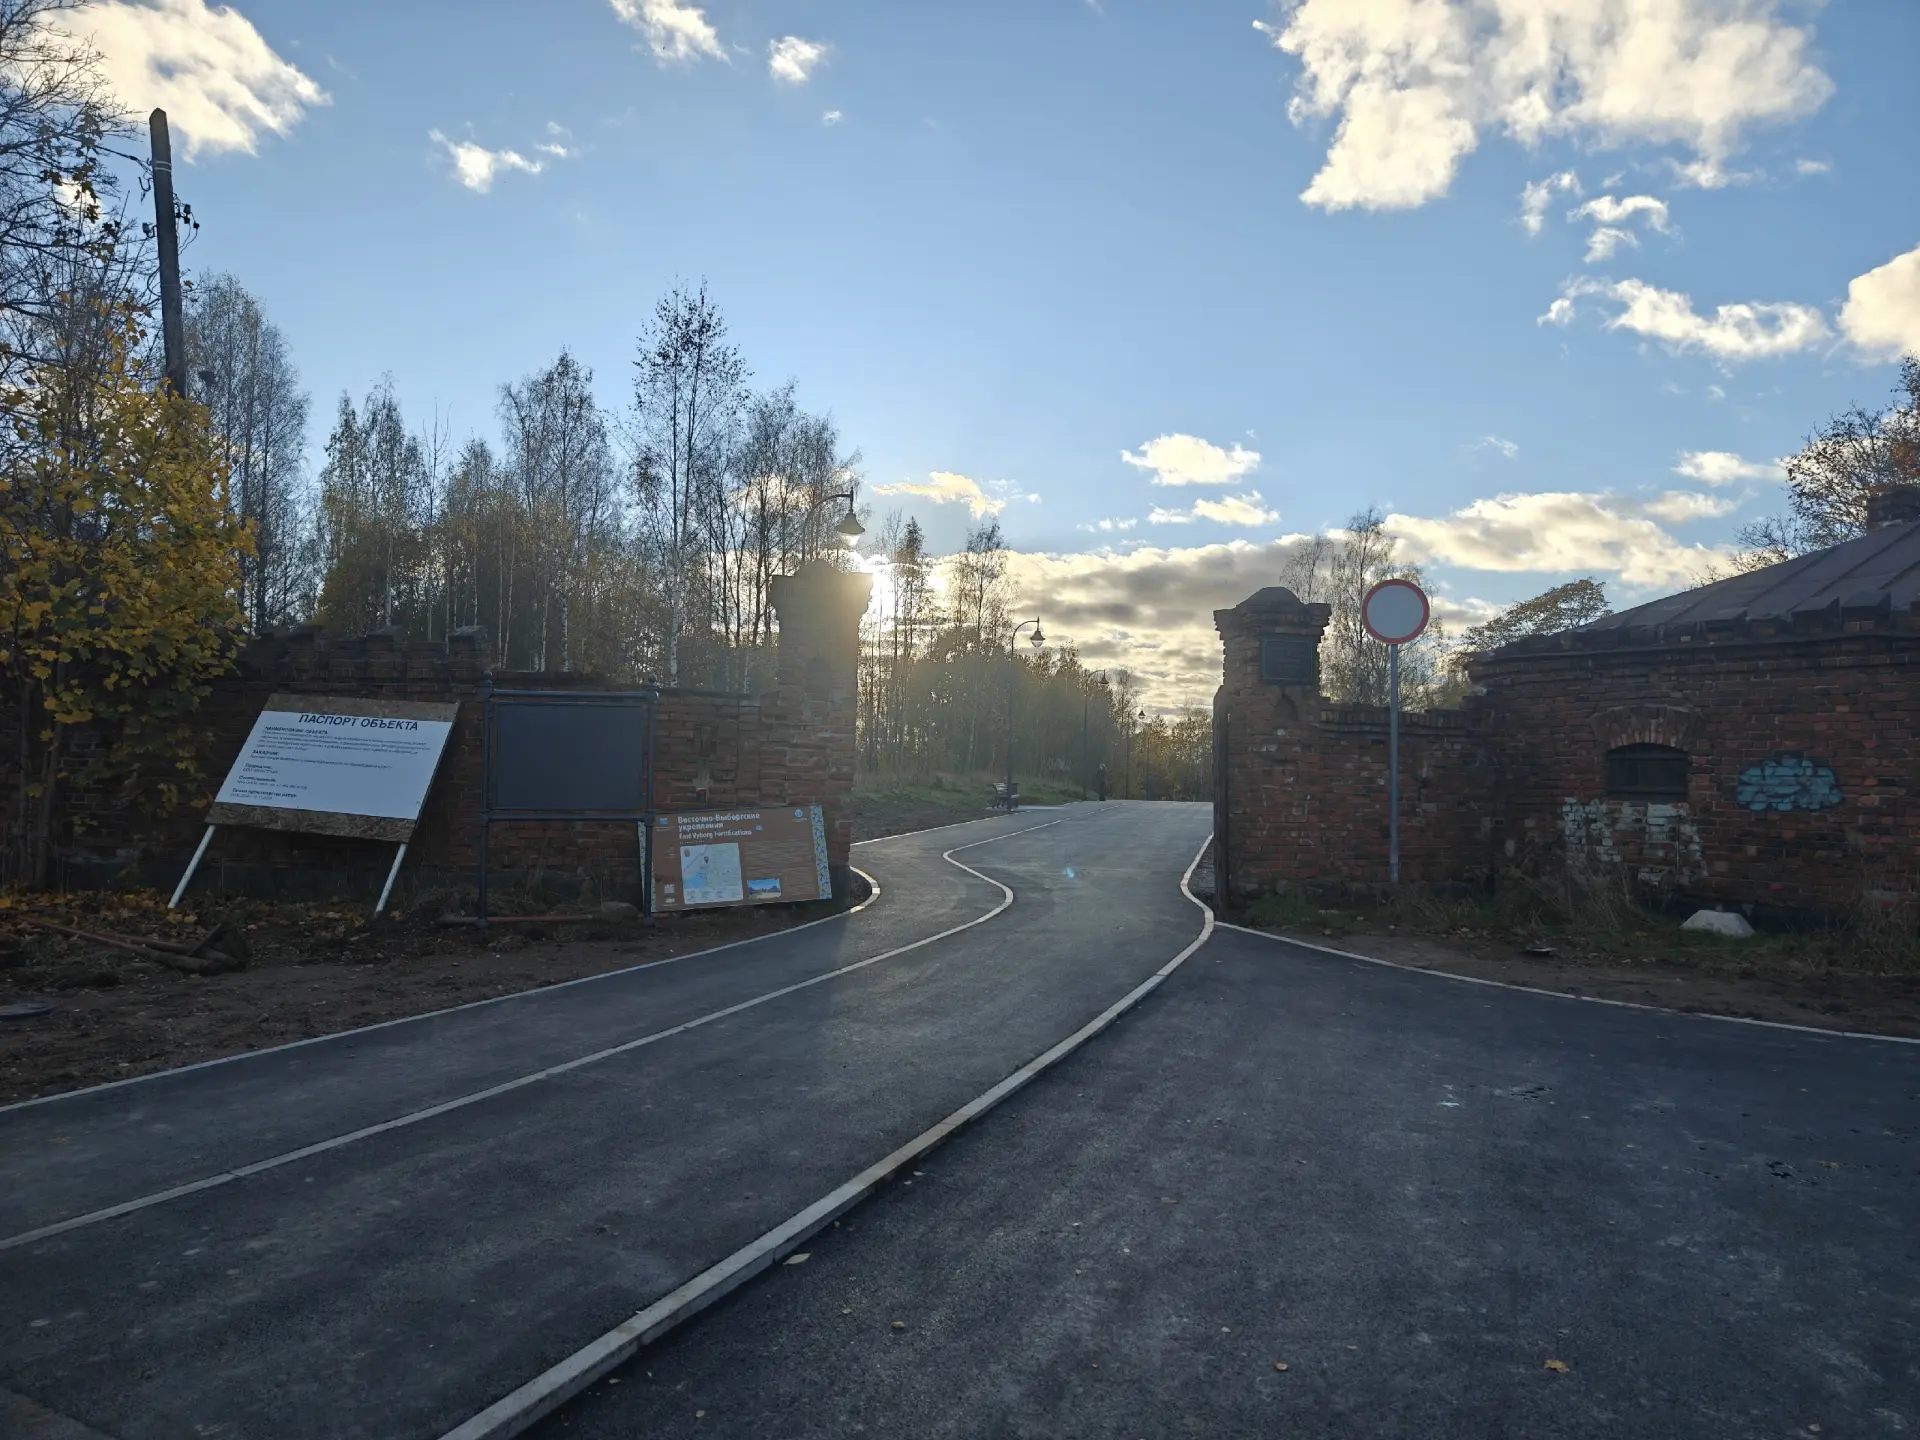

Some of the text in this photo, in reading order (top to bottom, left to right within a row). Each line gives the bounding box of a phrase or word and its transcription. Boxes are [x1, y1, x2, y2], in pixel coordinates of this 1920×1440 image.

[299, 714, 418, 731] ПАСПОРТ ОБЪЕКТА
[678, 812, 760, 824] Восточно-Выборгские
[692, 831, 713, 840] Vyborg
